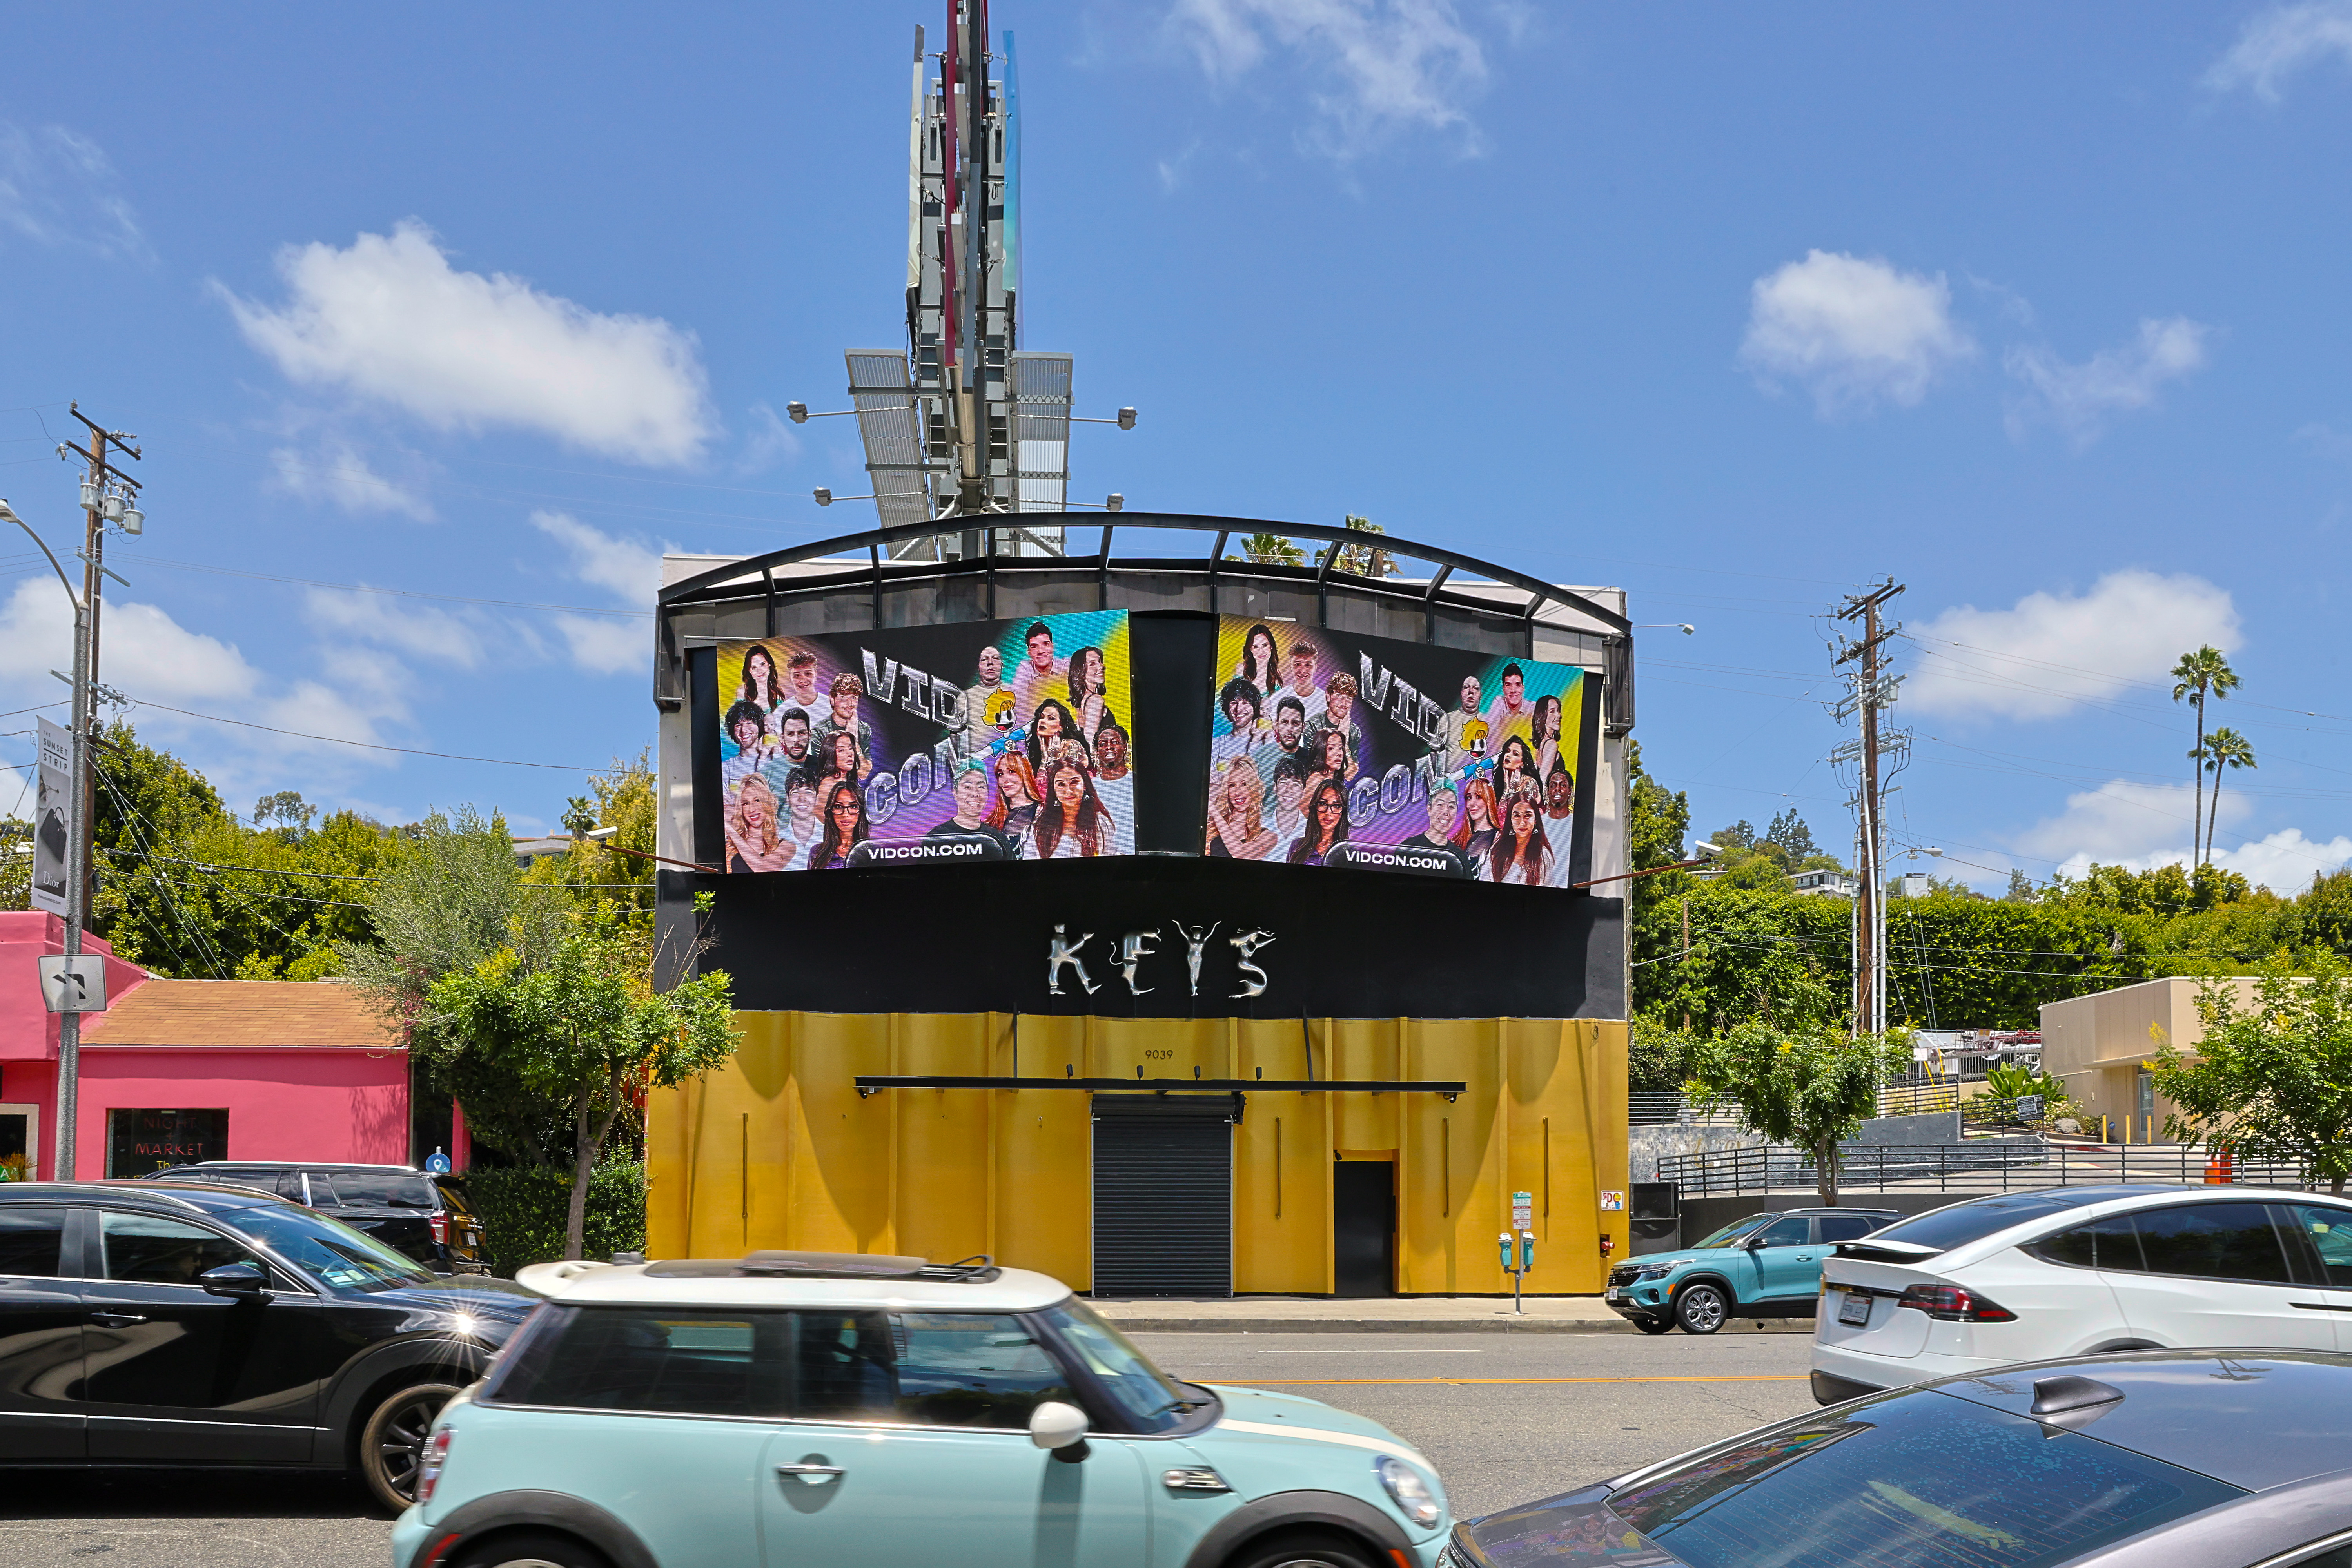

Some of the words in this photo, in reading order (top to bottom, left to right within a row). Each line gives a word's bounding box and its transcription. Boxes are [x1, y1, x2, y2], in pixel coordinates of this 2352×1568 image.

[860, 647, 967, 731] VID
[1359, 650, 1449, 748] VID
[44, 738, 67, 756] SUNSET
[44, 753, 67, 771] STRIP
[864, 728, 969, 824] CON
[1347, 746, 1446, 827] CON
[868, 843, 983, 860] VIDCON.COM
[1345, 850, 1447, 870] VIDCON.COM
[42, 871, 59, 888] Dior
[1047, 920, 1276, 998] KEYS
[1145, 1050, 1173, 1059] 9039
[144, 1117, 196, 1129] NIGHT
[135, 1143, 204, 1155] MARKET
